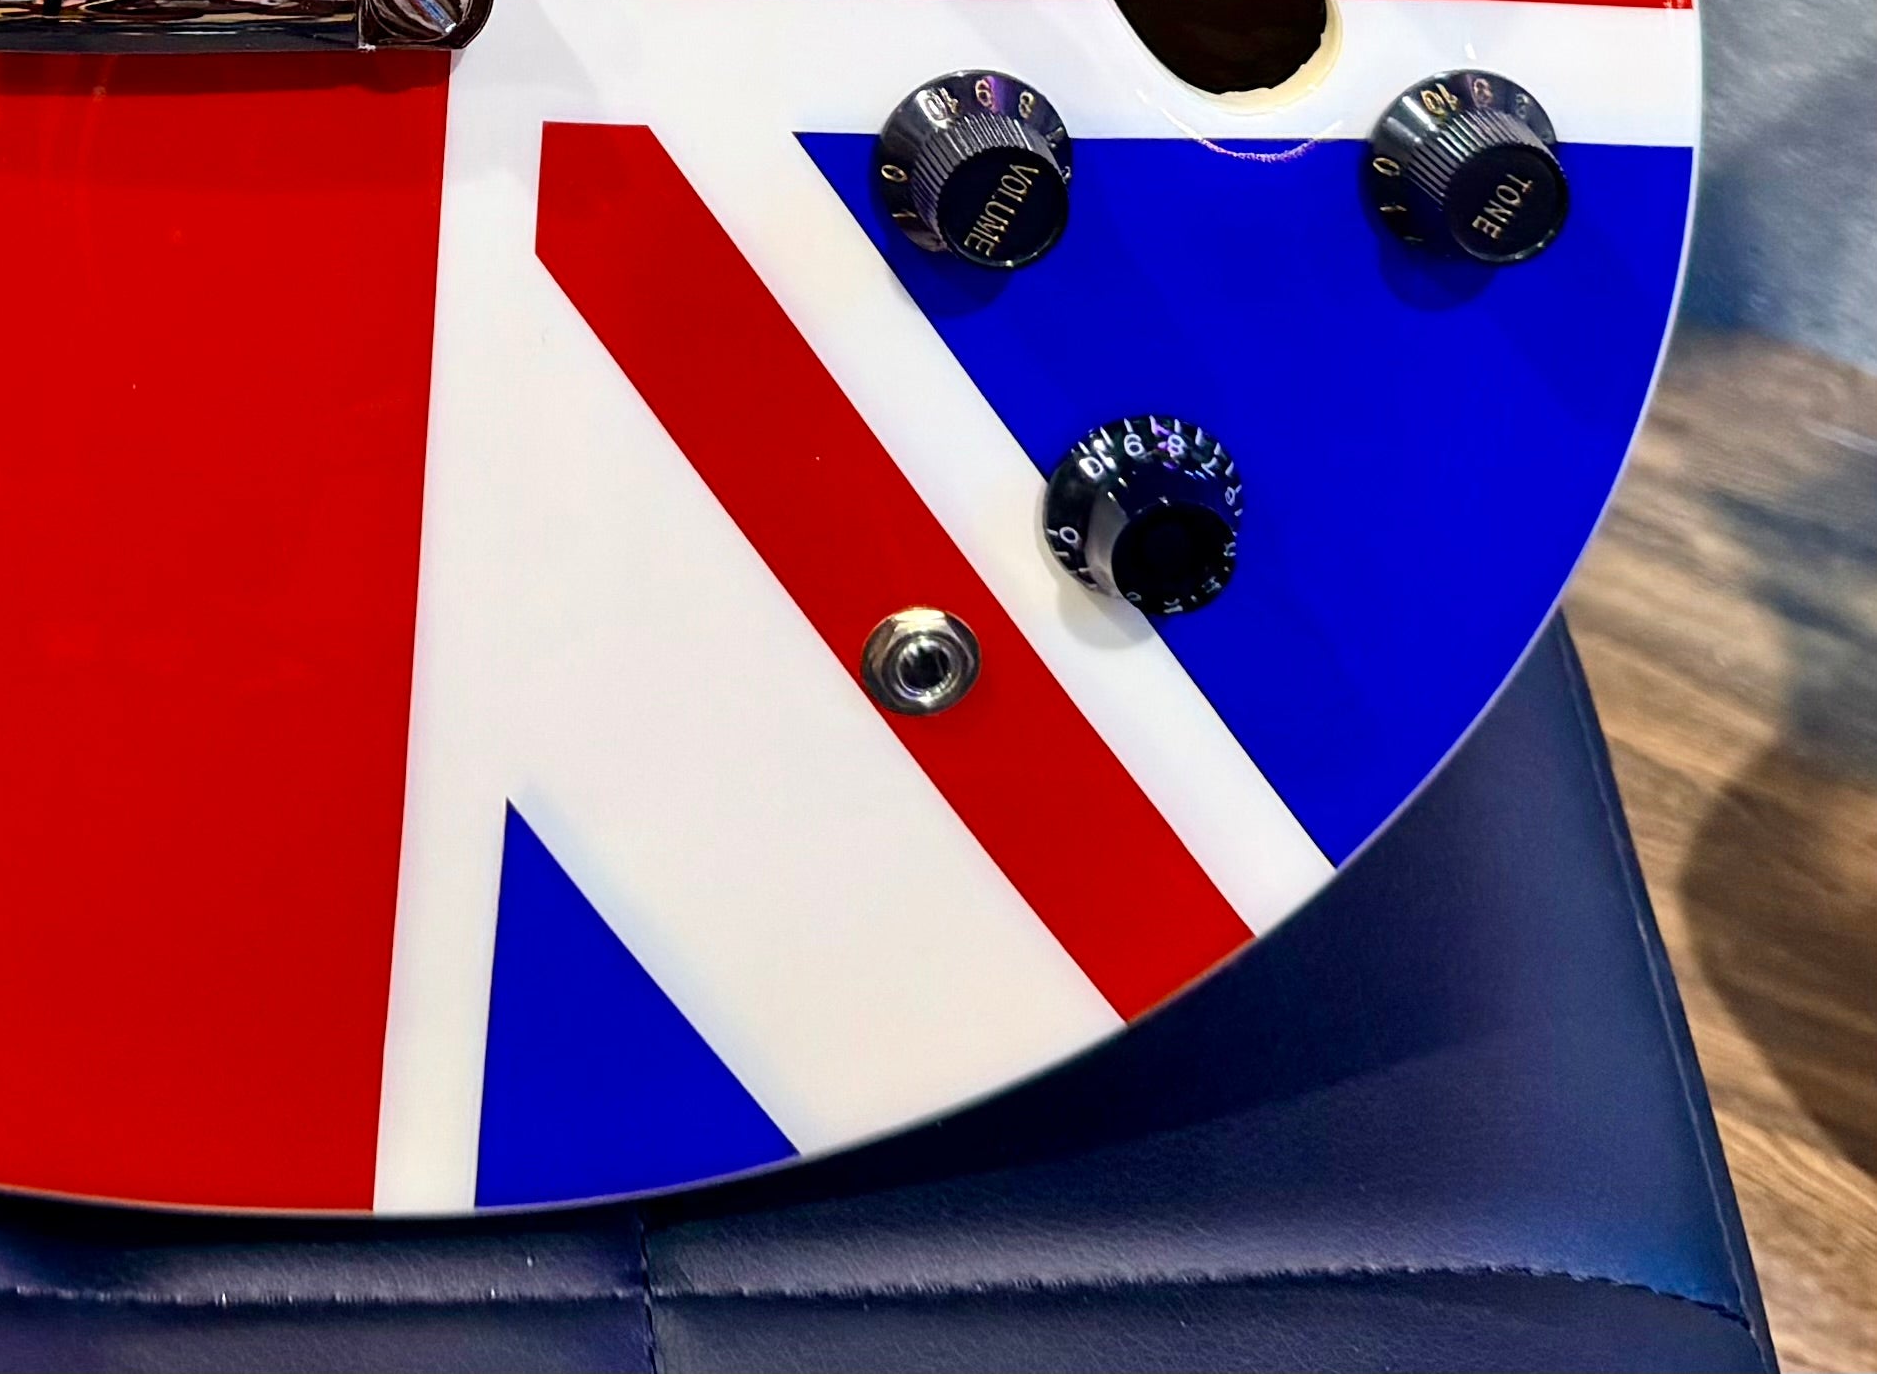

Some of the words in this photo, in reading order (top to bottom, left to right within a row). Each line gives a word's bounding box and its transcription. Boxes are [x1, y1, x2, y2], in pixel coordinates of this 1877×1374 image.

[1373, 157, 1400, 177] 0
[1421, 83, 1460, 116] 10
[881, 165, 908, 182] 0
[1472, 173, 1533, 239] TONE
[964, 164, 1040, 256] VOLUME
[1059, 526, 1080, 545] 0
